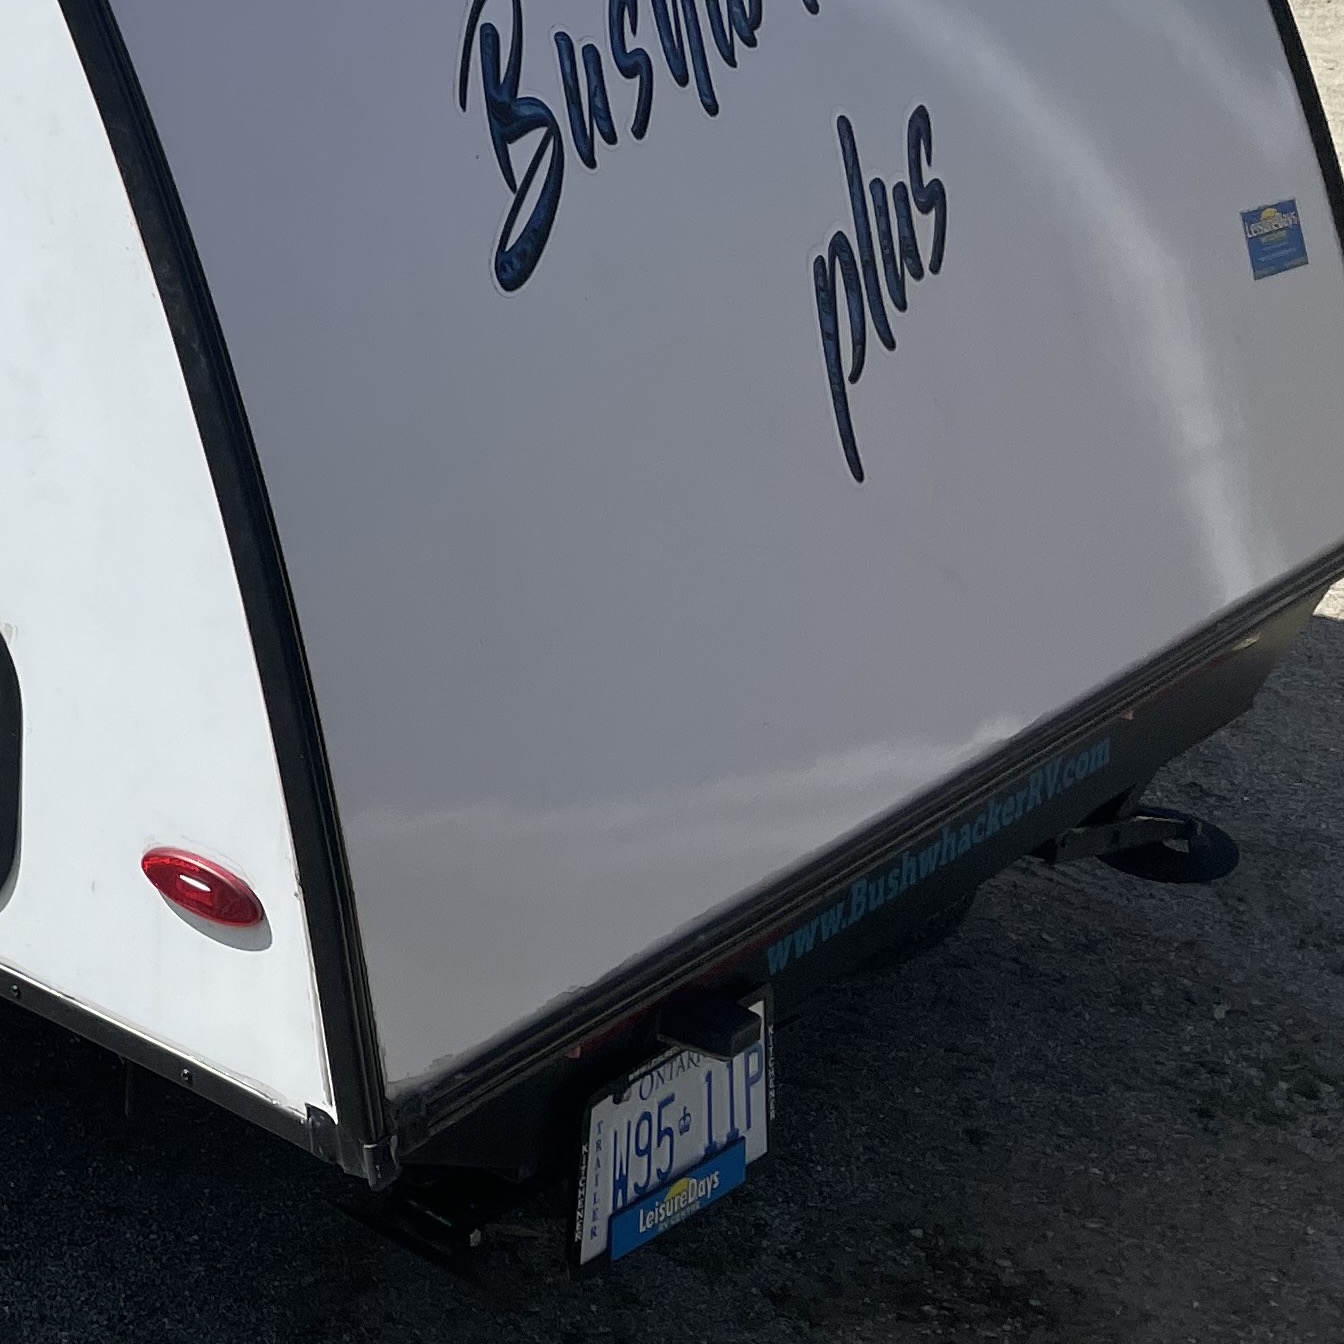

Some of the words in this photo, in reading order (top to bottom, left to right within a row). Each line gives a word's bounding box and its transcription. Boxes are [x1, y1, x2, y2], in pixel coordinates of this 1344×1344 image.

[812, 105, 948, 484] plus
[767, 737, 1112, 977] www.BushwhackerRV.com
[575, 1143, 588, 1243] KITCHENER
[589, 1119, 604, 1240] TRAILER
[638, 1169, 720, 1234] LeisureDays
